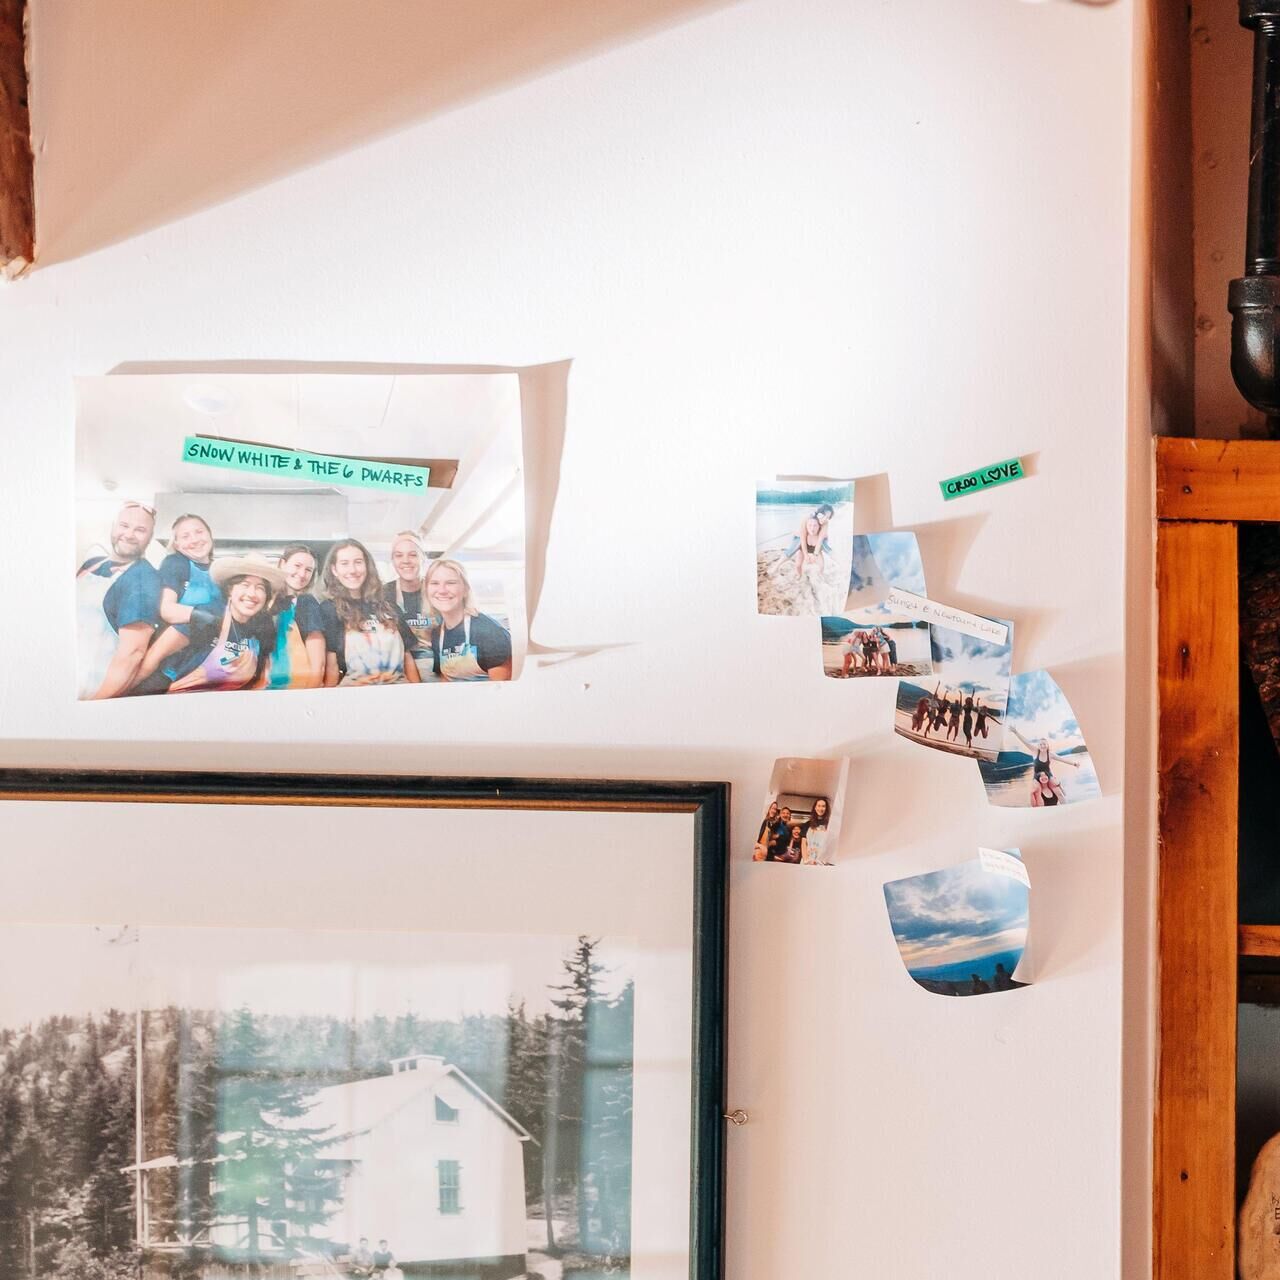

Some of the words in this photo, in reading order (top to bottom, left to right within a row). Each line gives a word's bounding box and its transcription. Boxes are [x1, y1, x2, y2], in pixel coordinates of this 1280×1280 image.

[188, 443, 235, 463] SNOW
[238, 451, 291, 469] WHITE
[293, 458, 302, 471] &
[308, 459, 341, 475] THE
[343, 464, 354, 479] 6
[361, 467, 424, 488] DWARFS
[947, 477, 978, 494] CROO
